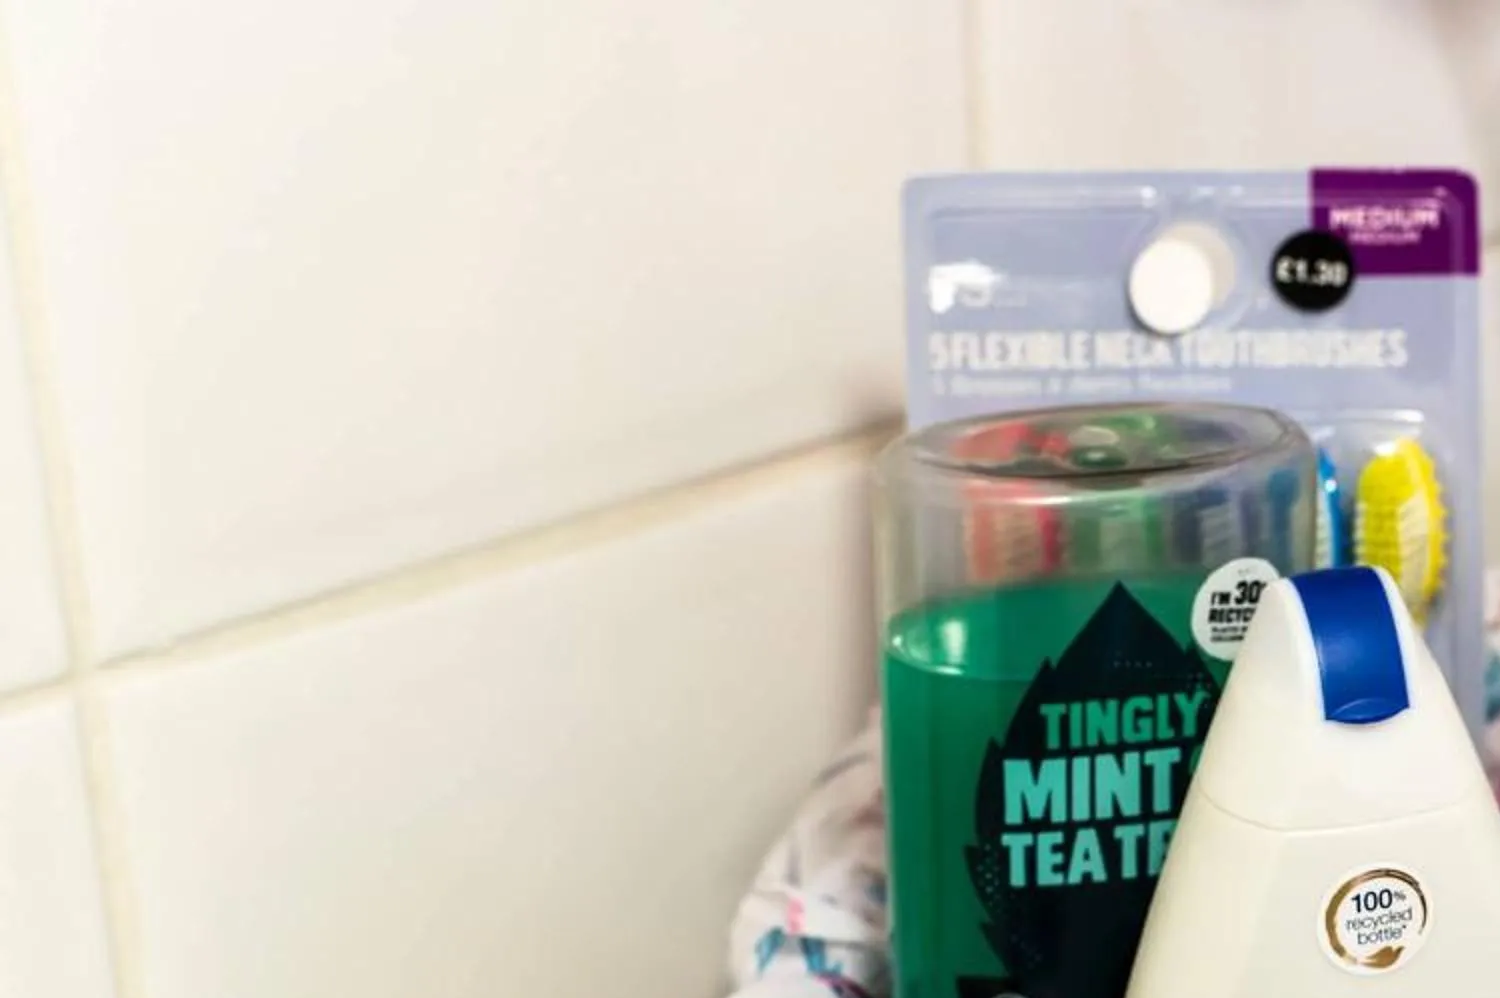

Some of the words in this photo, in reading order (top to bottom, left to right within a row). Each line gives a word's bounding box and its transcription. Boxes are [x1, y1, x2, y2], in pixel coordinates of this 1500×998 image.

[1329, 204, 1440, 230] MEDIUM
[950, 329, 1091, 370] FLEXIBLE
[1095, 329, 1174, 369] NECK
[1177, 328, 1409, 368] TOOTHBRUSHES
[1040, 690, 1209, 749] TINGLY
[1003, 748, 1181, 825] MINT
[1001, 828, 1108, 888] TEA
[1346, 908, 1412, 931] recycled
[1350, 888, 1407, 913] 100%
